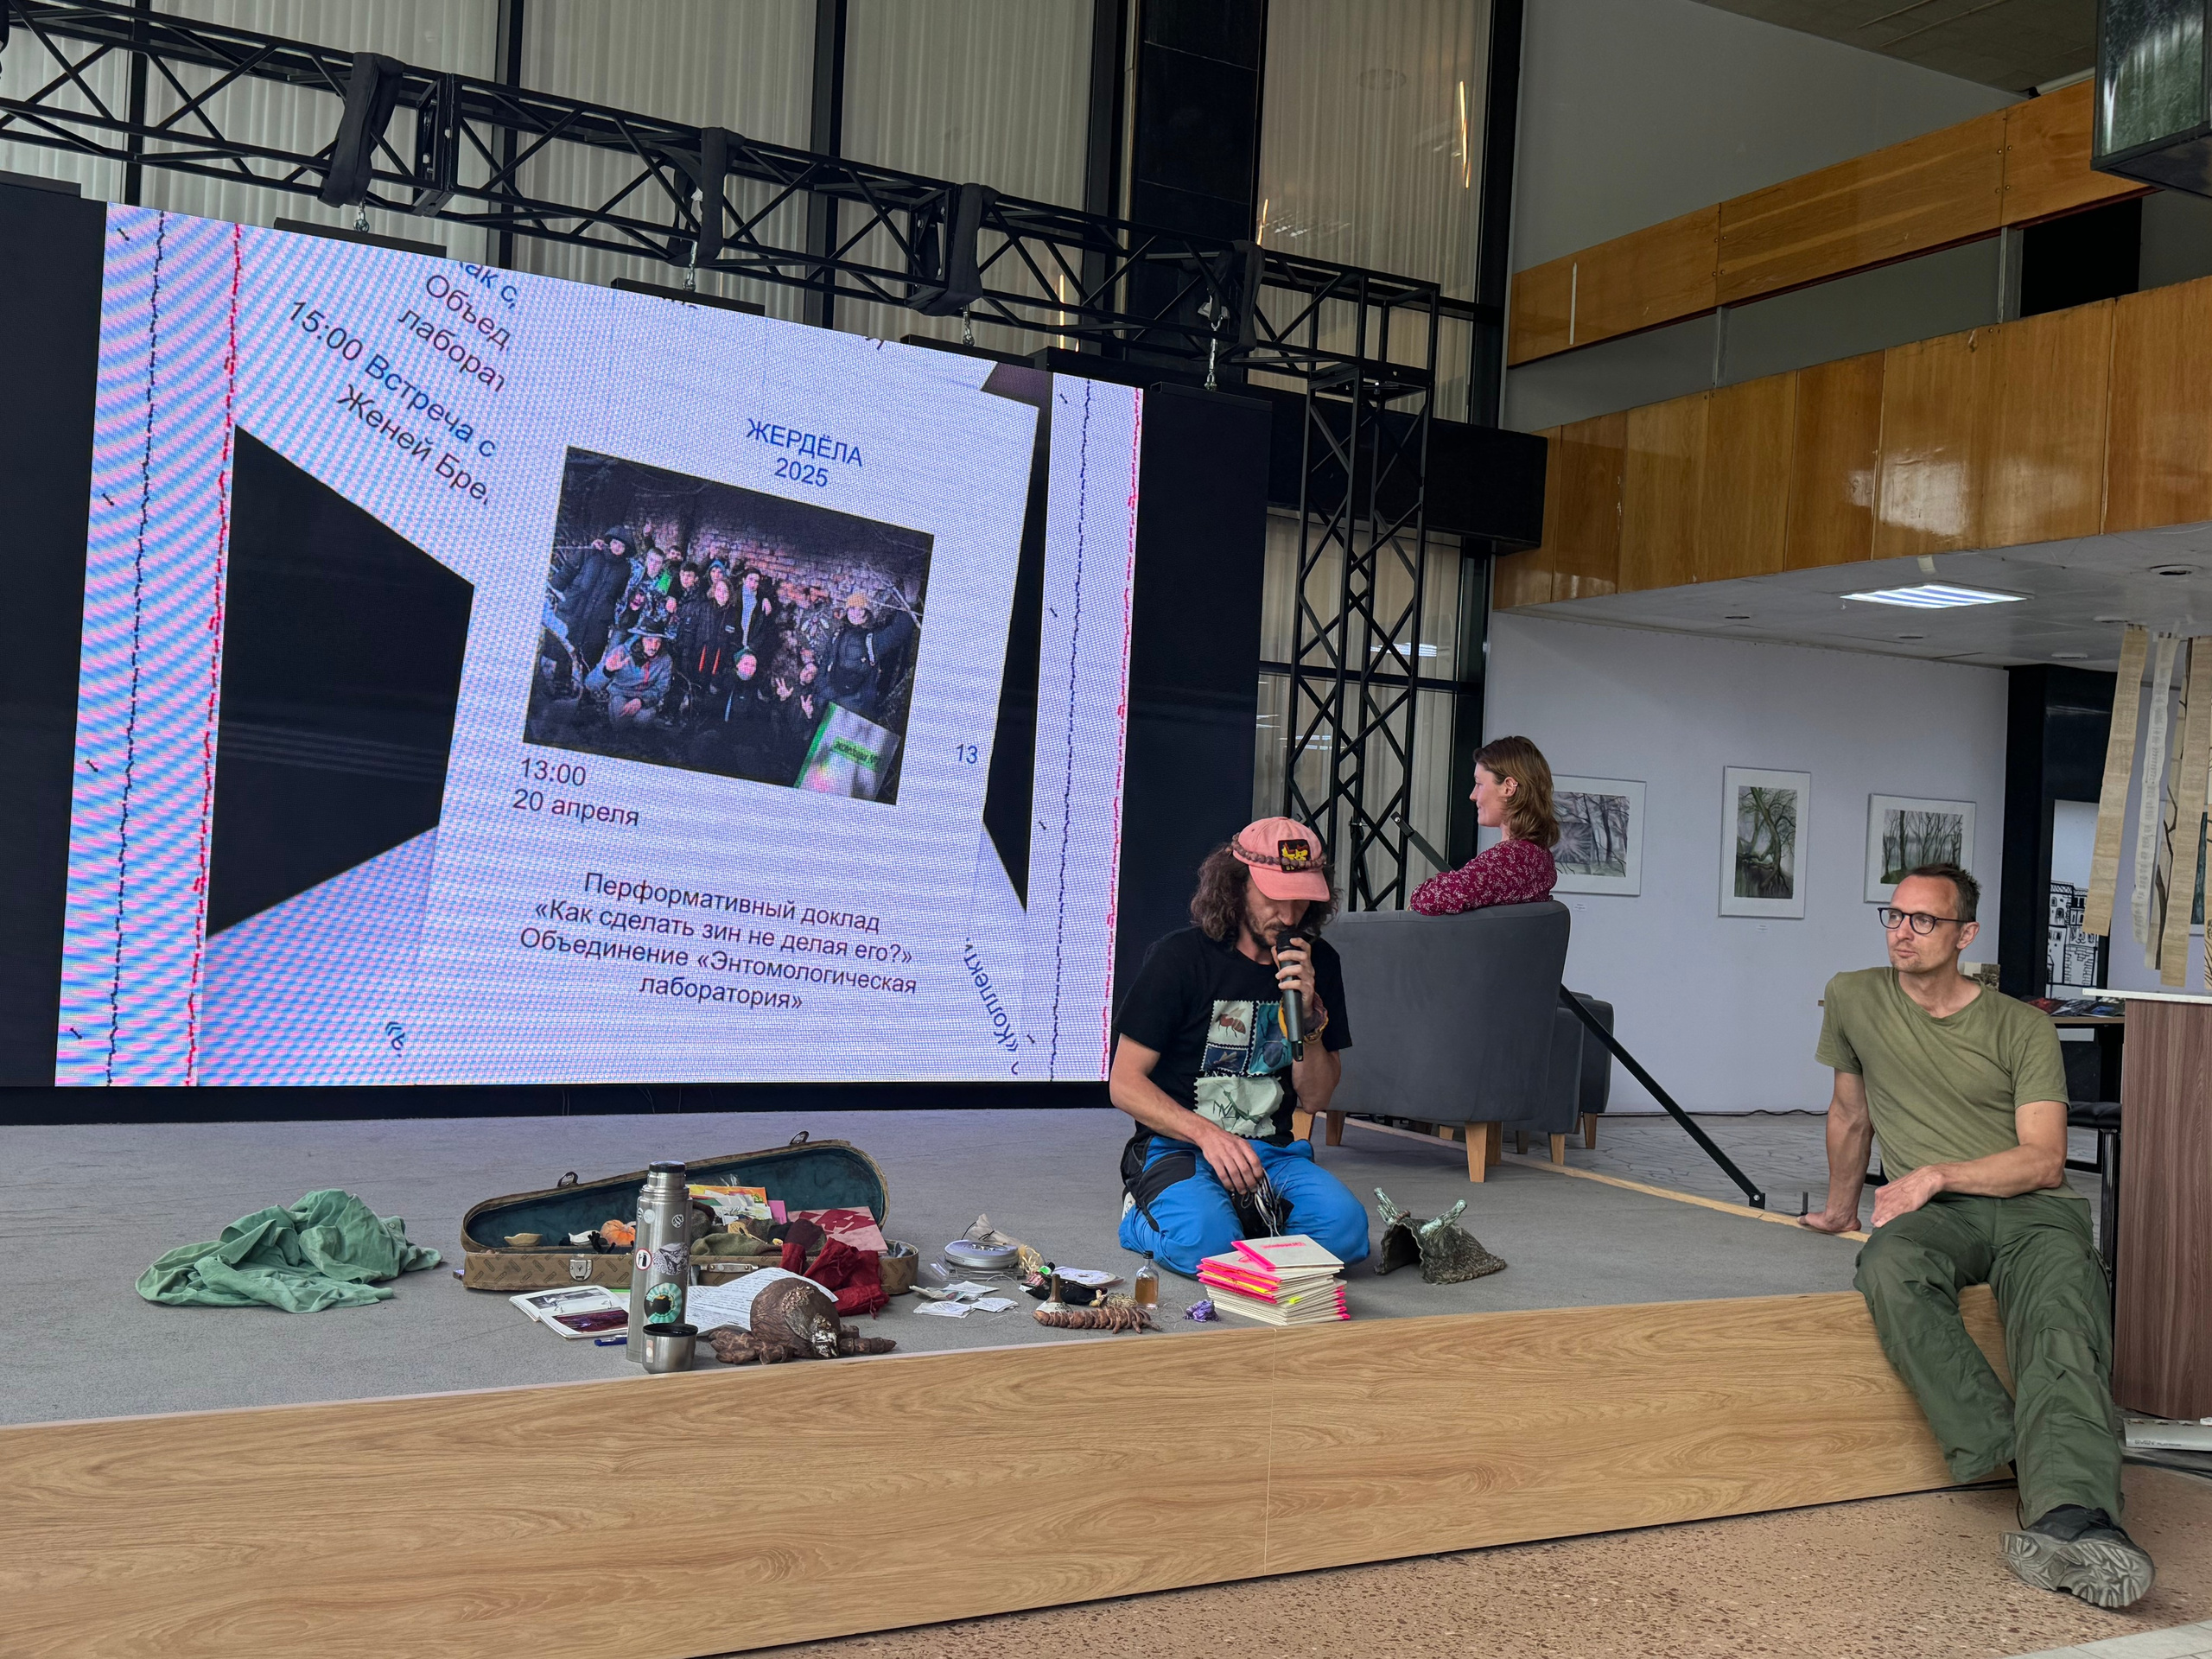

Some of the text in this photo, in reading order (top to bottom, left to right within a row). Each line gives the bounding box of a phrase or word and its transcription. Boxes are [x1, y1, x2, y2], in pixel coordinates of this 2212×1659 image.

[460, 261, 499, 289] ак
[427, 274, 512, 353] Объед
[290, 301, 497, 458] 15:00 Встреча с
[337, 385, 489, 505] Женей Бре
[746, 419, 863, 467] ЖЕРДЁЛА
[774, 458, 829, 488] 2025
[519, 758, 587, 787] 13:00
[956, 742, 980, 765] 13
[512, 789, 640, 827] 20 апреля
[583, 872, 881, 934] Перформативный доклад
[536, 900, 913, 965] «Как сделать зин не делая его?»
[519, 928, 918, 995] Объединение «Энтомологическая
[639, 976, 804, 1013] лаборатория»
[963, 937, 1019, 1052] «Коллект
